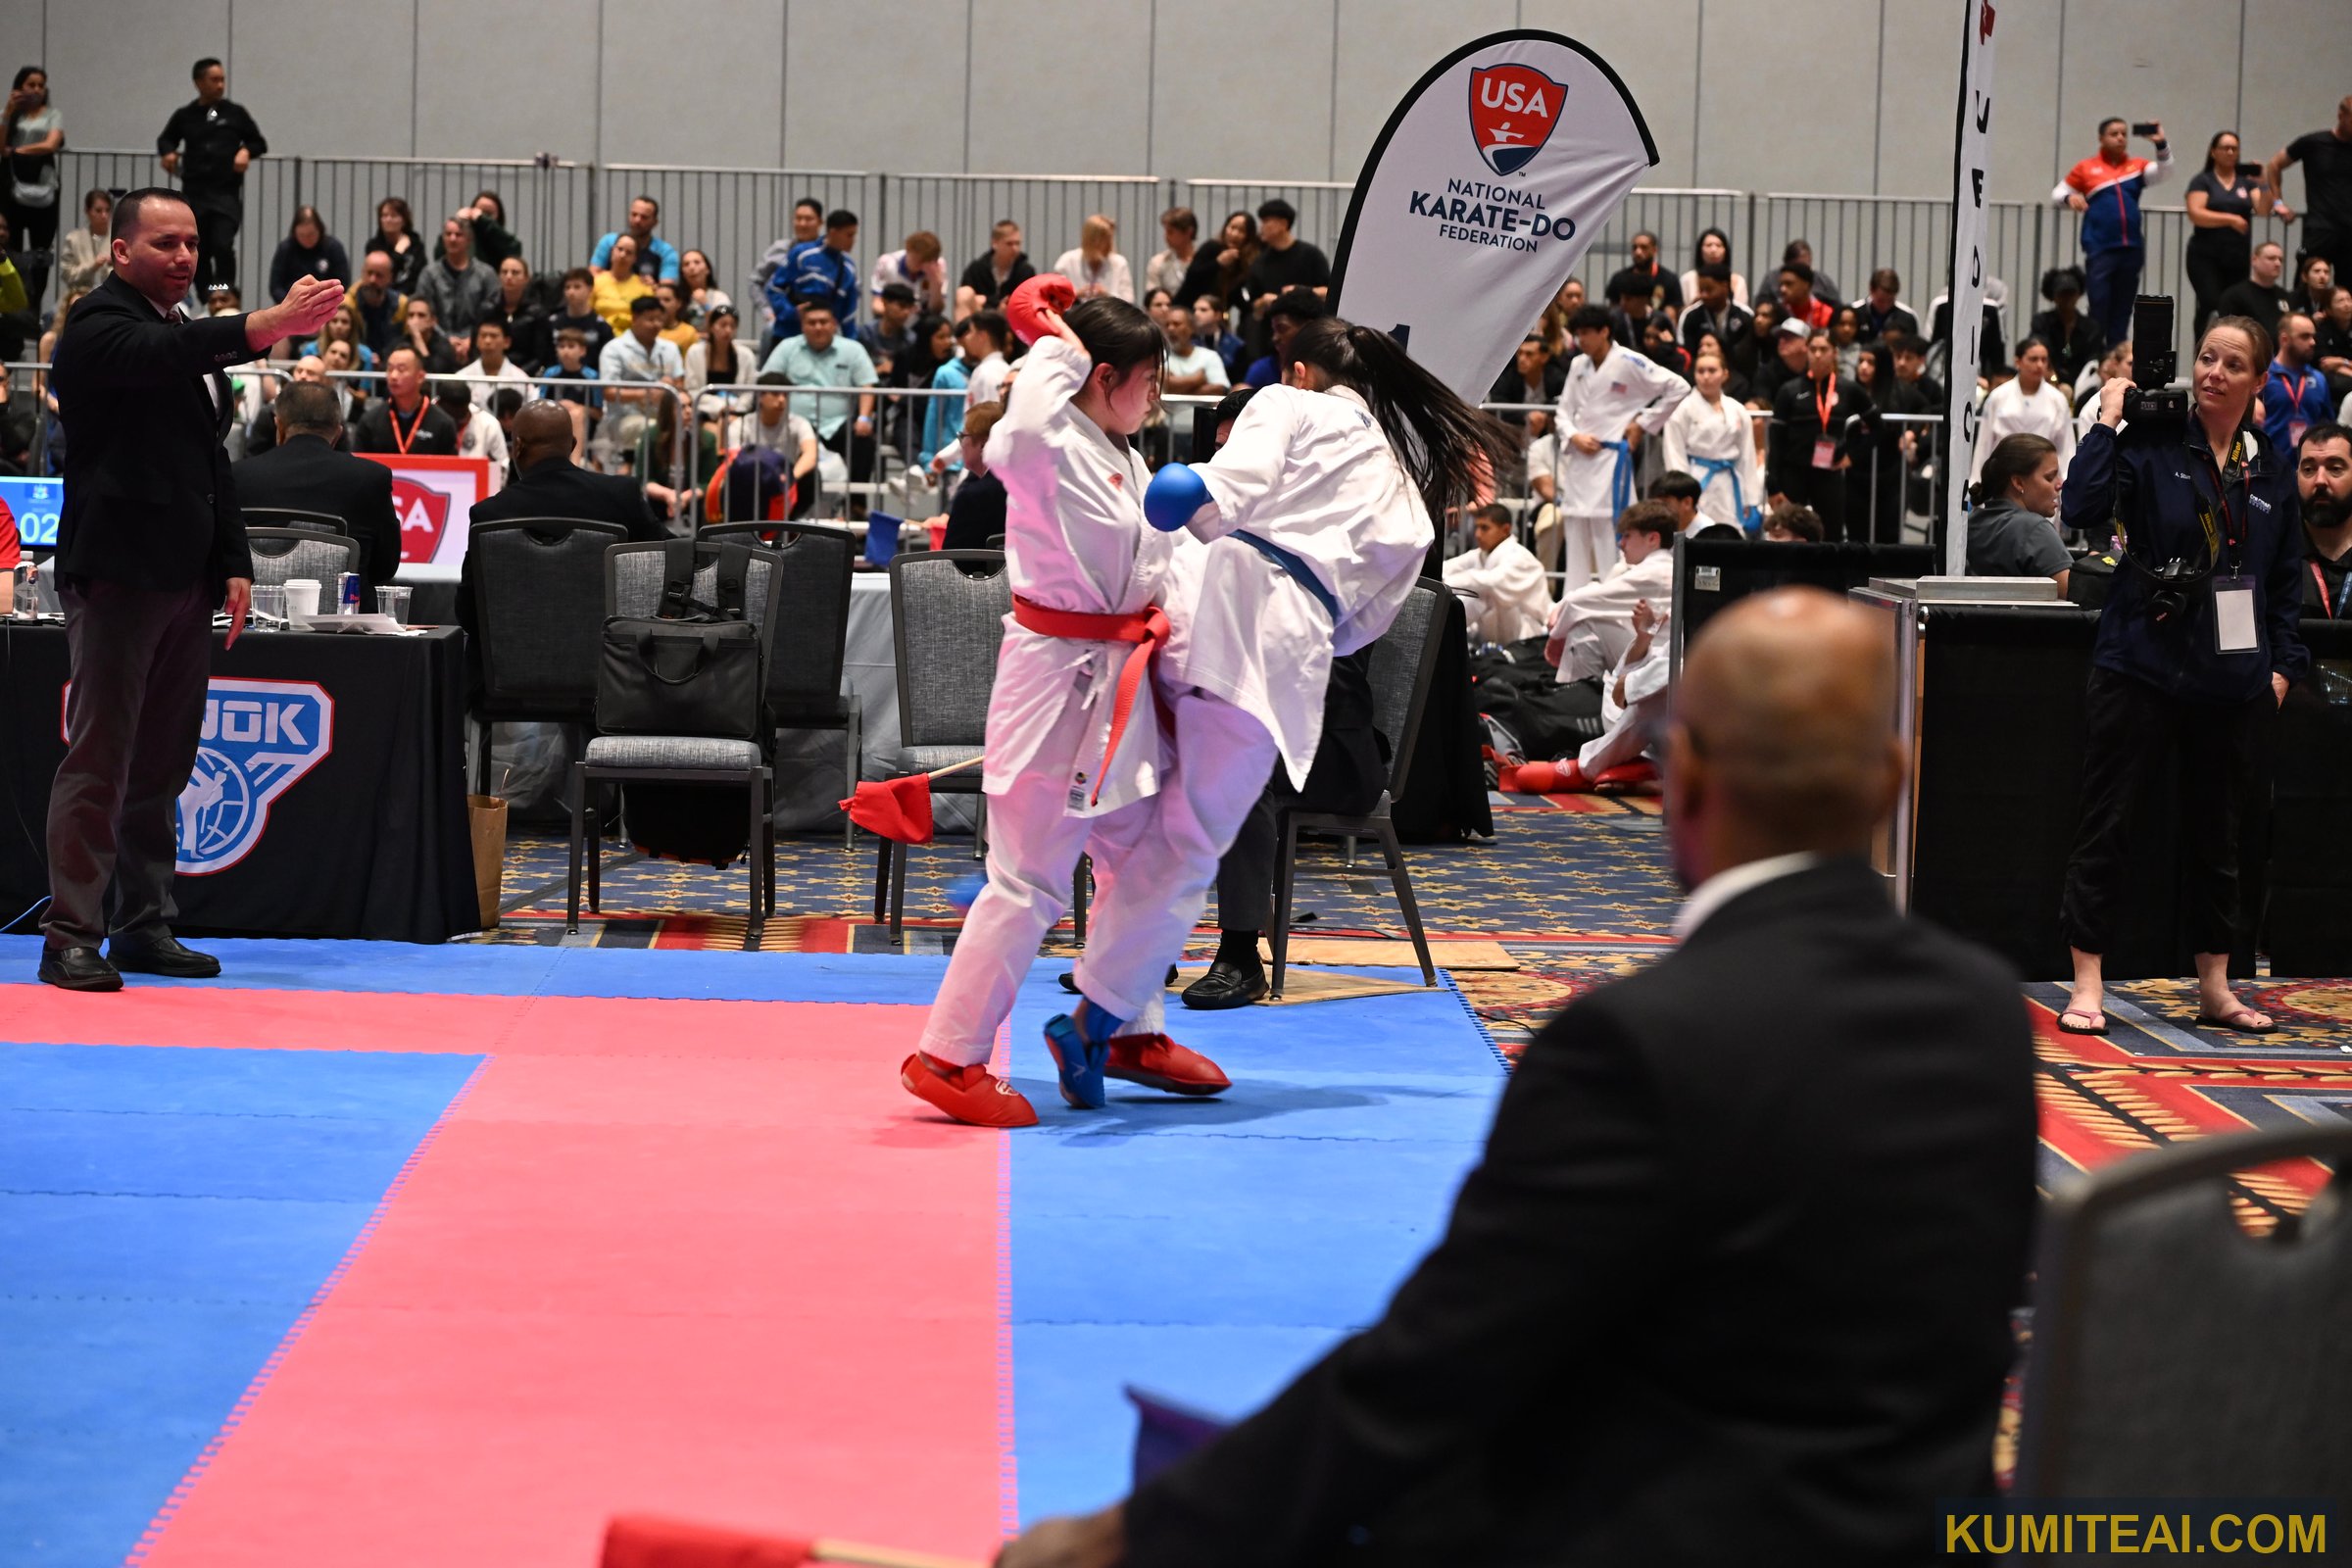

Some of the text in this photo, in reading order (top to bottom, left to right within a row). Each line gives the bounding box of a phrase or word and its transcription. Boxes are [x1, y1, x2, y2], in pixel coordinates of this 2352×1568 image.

[1481, 77, 1547, 118] USA
[1447, 178, 1545, 210] NATIONAL
[1409, 190, 1576, 241] KARATE-DO
[1440, 223, 1538, 253] FEDERATION
[20, 513, 60, 544] 02
